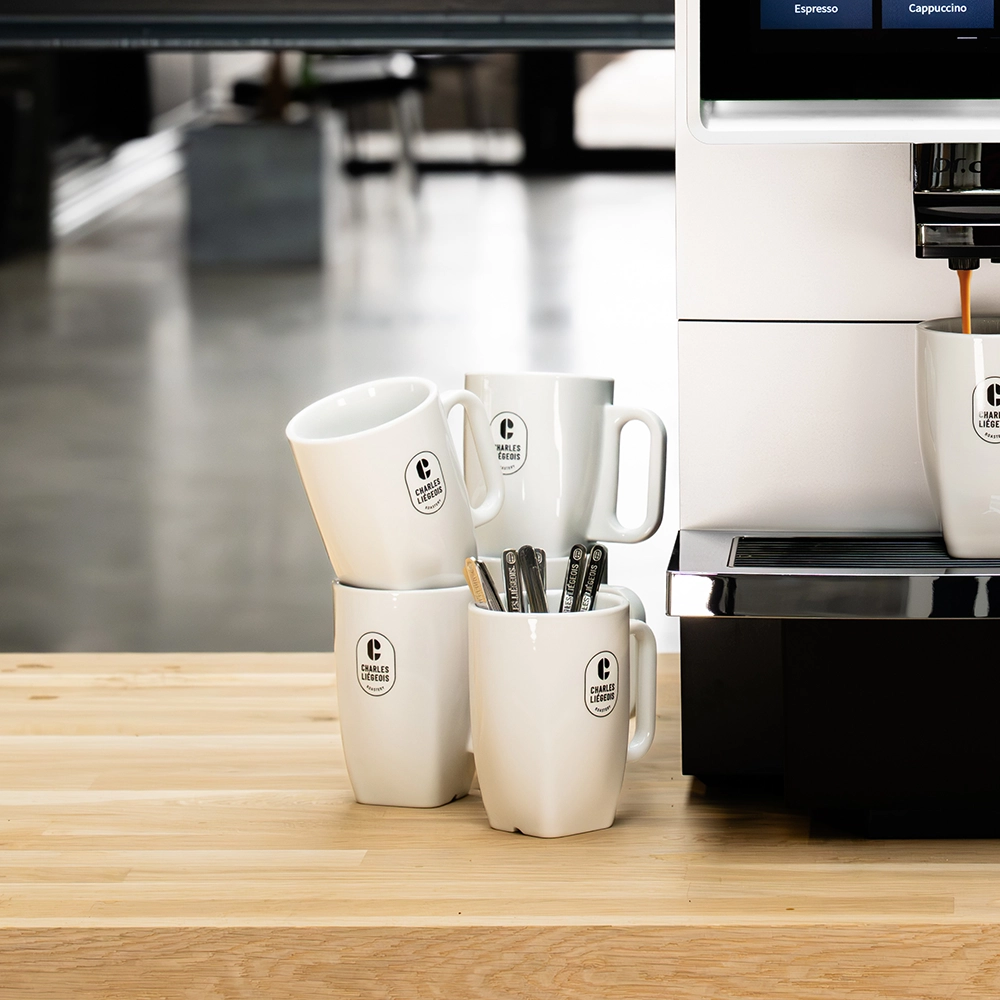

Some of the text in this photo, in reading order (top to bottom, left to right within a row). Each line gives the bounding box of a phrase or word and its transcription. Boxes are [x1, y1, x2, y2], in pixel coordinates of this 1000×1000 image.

[794, 4, 839, 17] Espresso
[908, 2, 968, 16] Cappuccino
[495, 444, 521, 452] HARLES
[497, 451, 521, 461] ÉGEOIS
[415, 477, 441, 496] CHARLES
[416, 485, 443, 504] LIÉGEOIS
[565, 563, 579, 597] LIÉGEOIS
[585, 564, 598, 598] LIÉGEOIS
[361, 664, 390, 674] CHARLES
[361, 672, 390, 682] LIÉGEOIS
[590, 683, 615, 694] CHARLES
[590, 692, 615, 703] LIÉGEOIS
